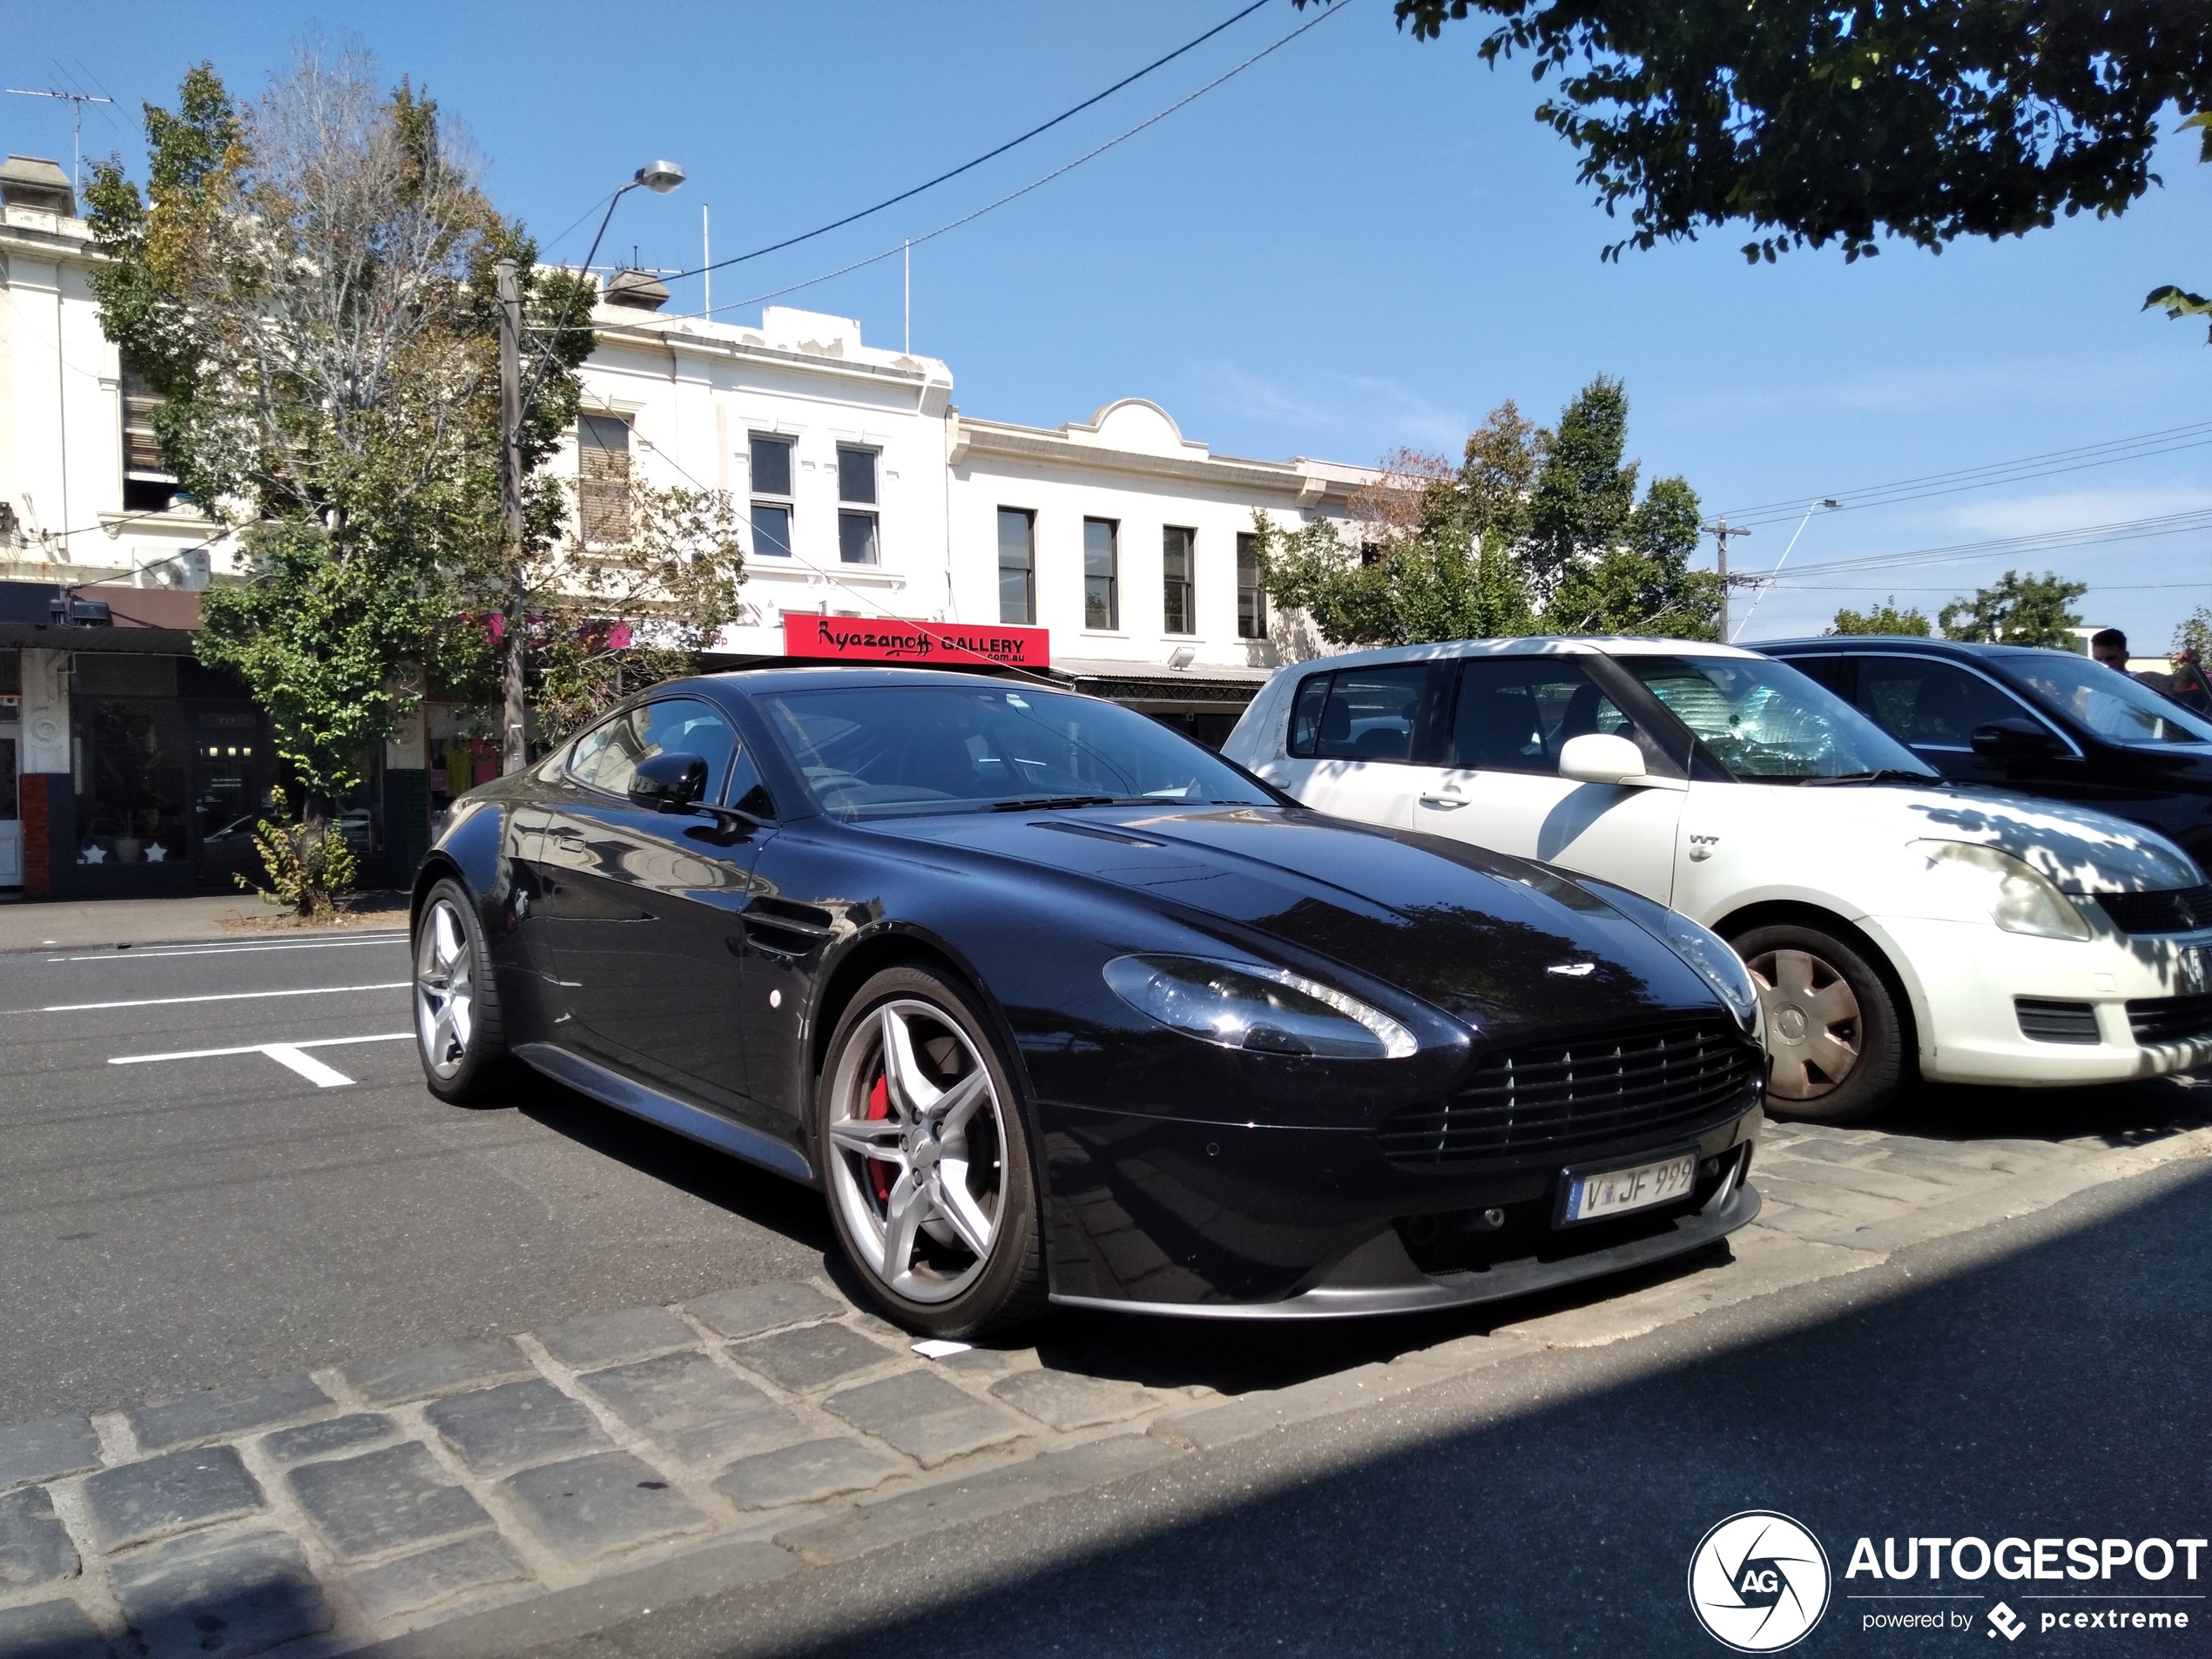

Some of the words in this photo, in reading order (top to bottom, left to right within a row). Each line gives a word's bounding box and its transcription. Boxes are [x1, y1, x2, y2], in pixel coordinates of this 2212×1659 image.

[818, 620, 934, 657] Ryazanoff
[941, 636, 1024, 653] GALLERY
[1655, 1158, 1693, 1195] 999
